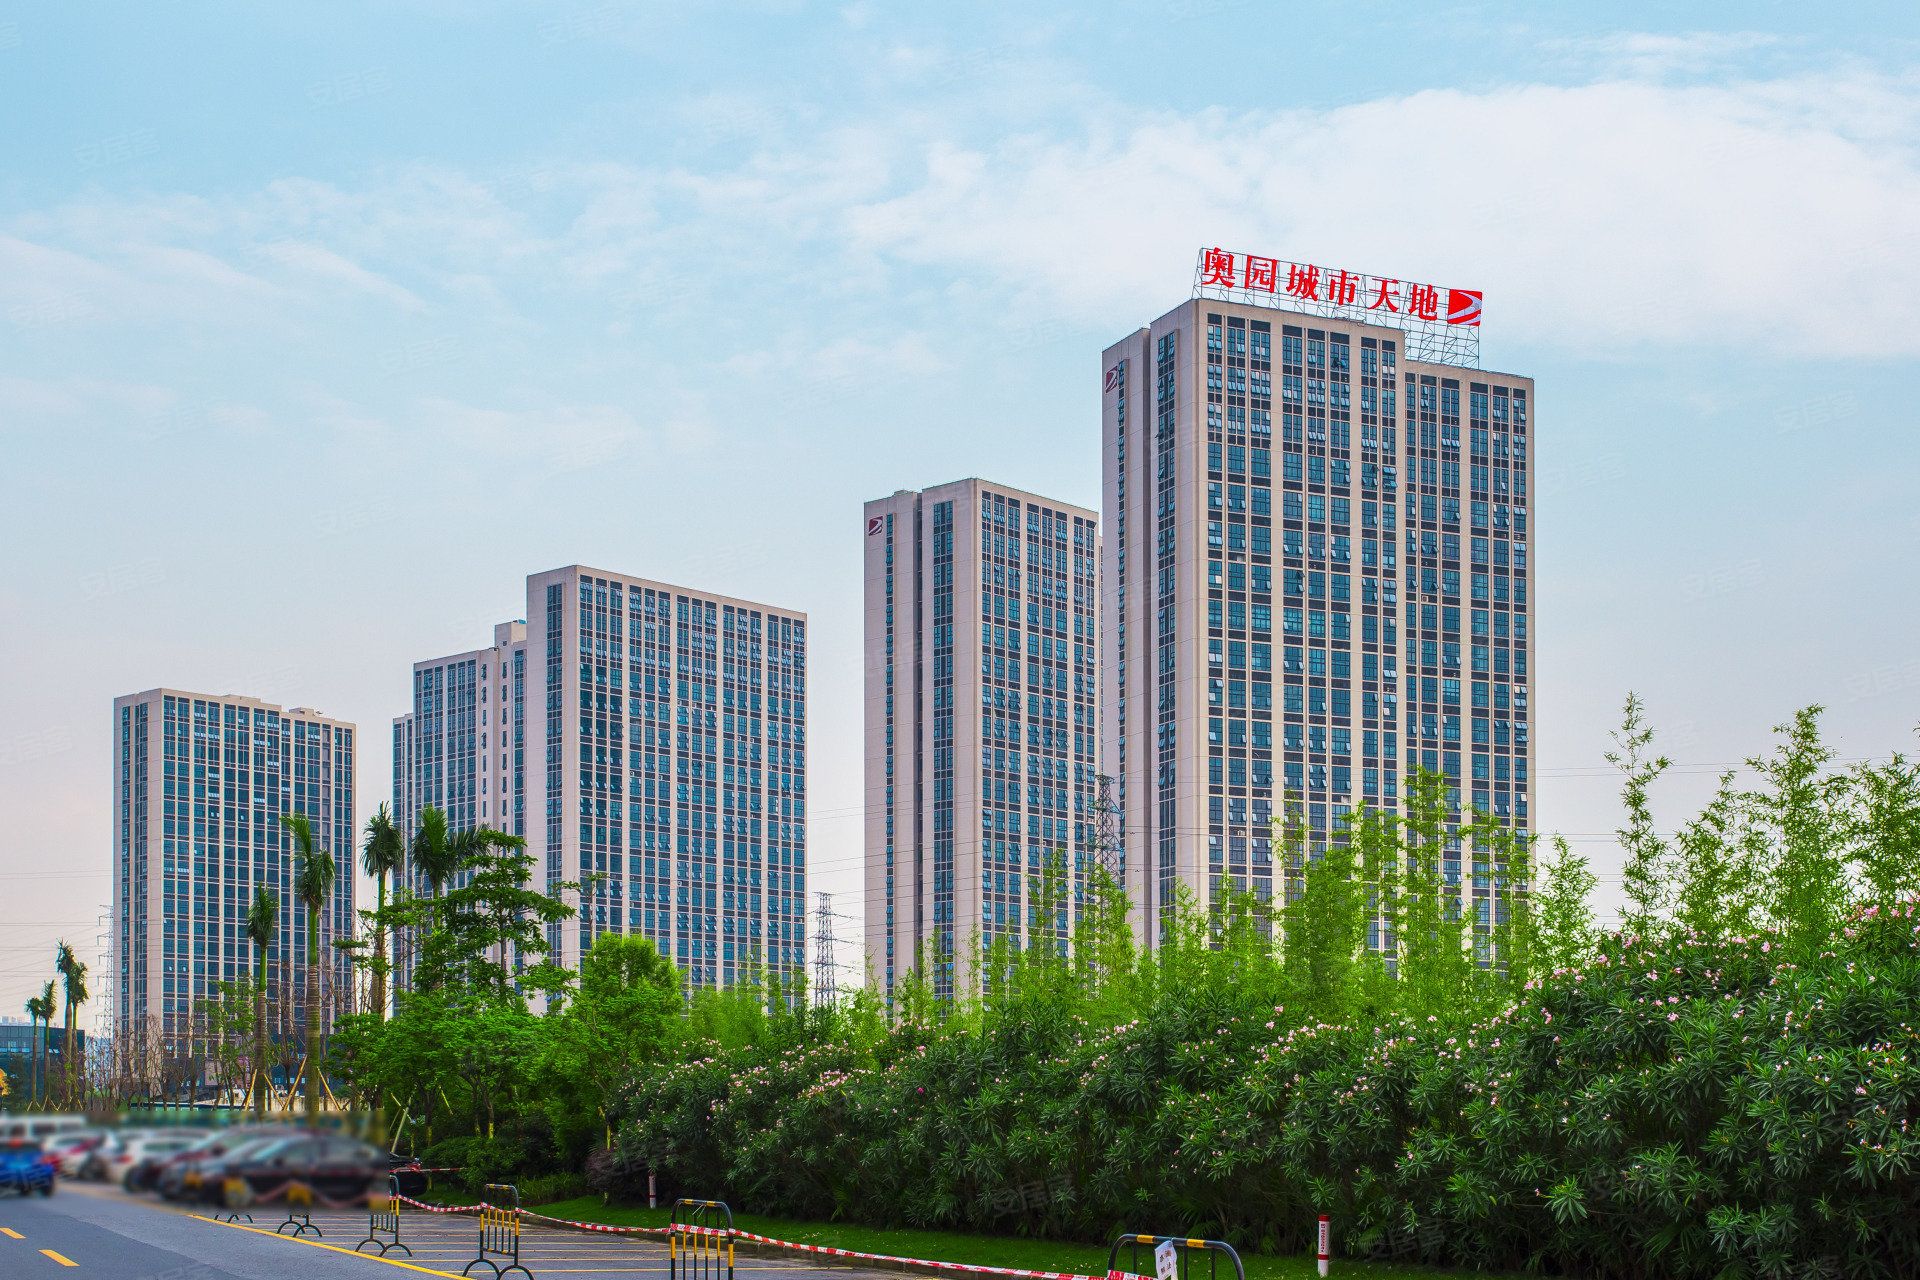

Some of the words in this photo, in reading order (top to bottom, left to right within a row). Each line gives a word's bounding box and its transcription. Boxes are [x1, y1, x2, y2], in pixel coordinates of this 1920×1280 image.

[1203, 247, 1438, 320] 奥园城市天地
